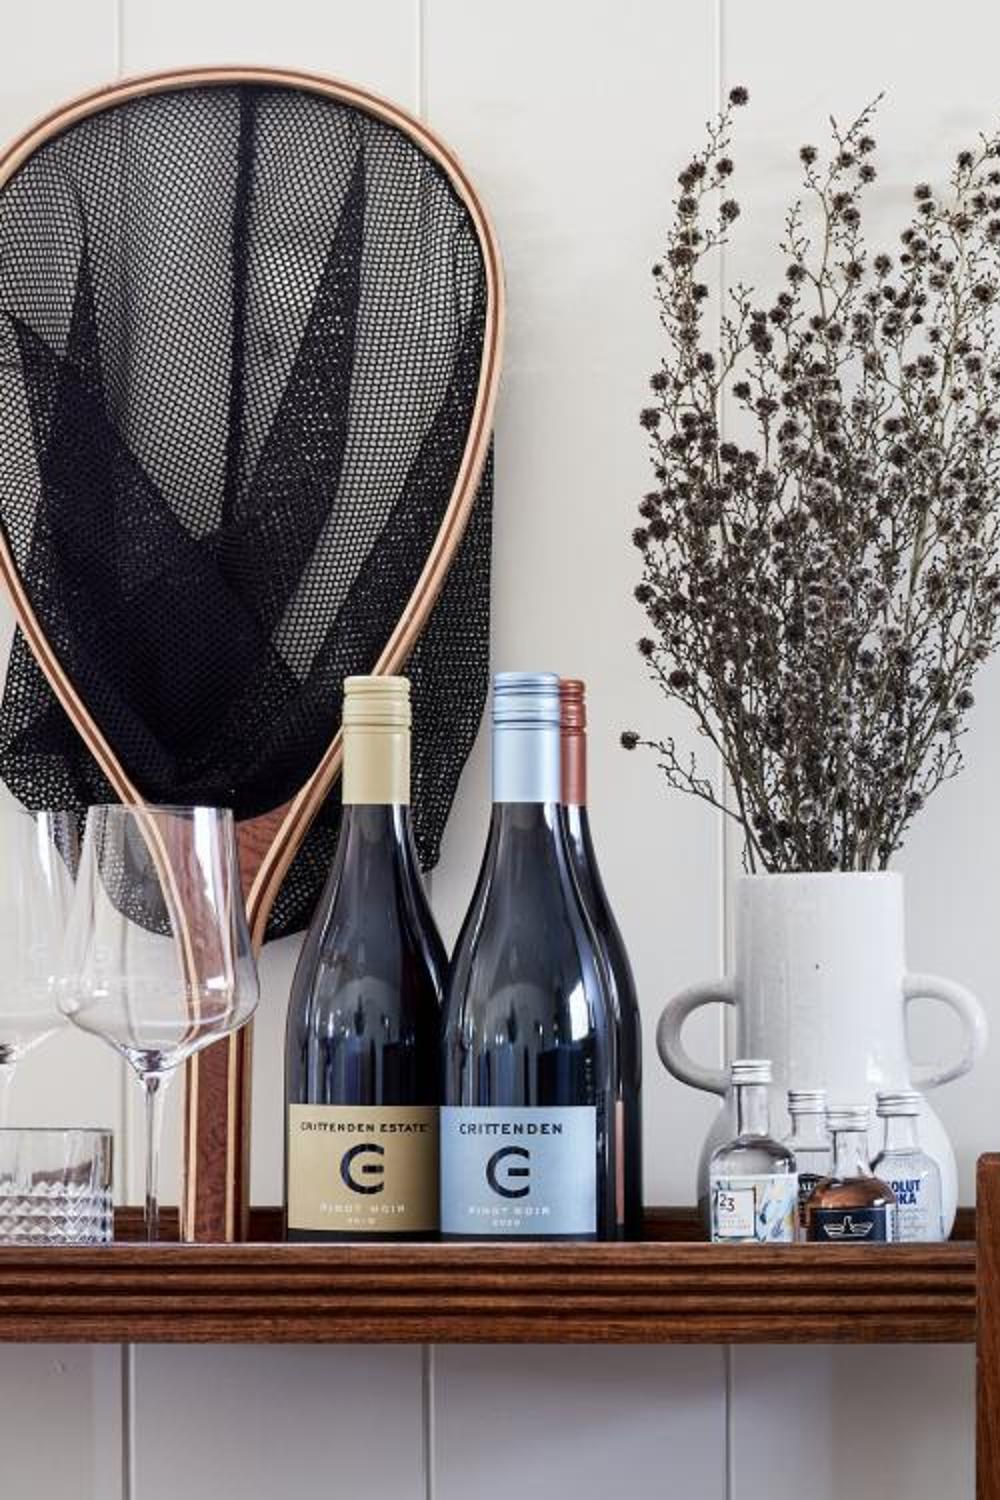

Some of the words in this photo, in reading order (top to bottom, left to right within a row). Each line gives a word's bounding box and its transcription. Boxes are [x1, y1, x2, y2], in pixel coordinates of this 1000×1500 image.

[300, 1121, 375, 1133] CRITTENDEN
[379, 1123, 428, 1134] ESTATE
[458, 1122, 563, 1135] CRITTENDEN
[888, 1179, 921, 1192] OLUT
